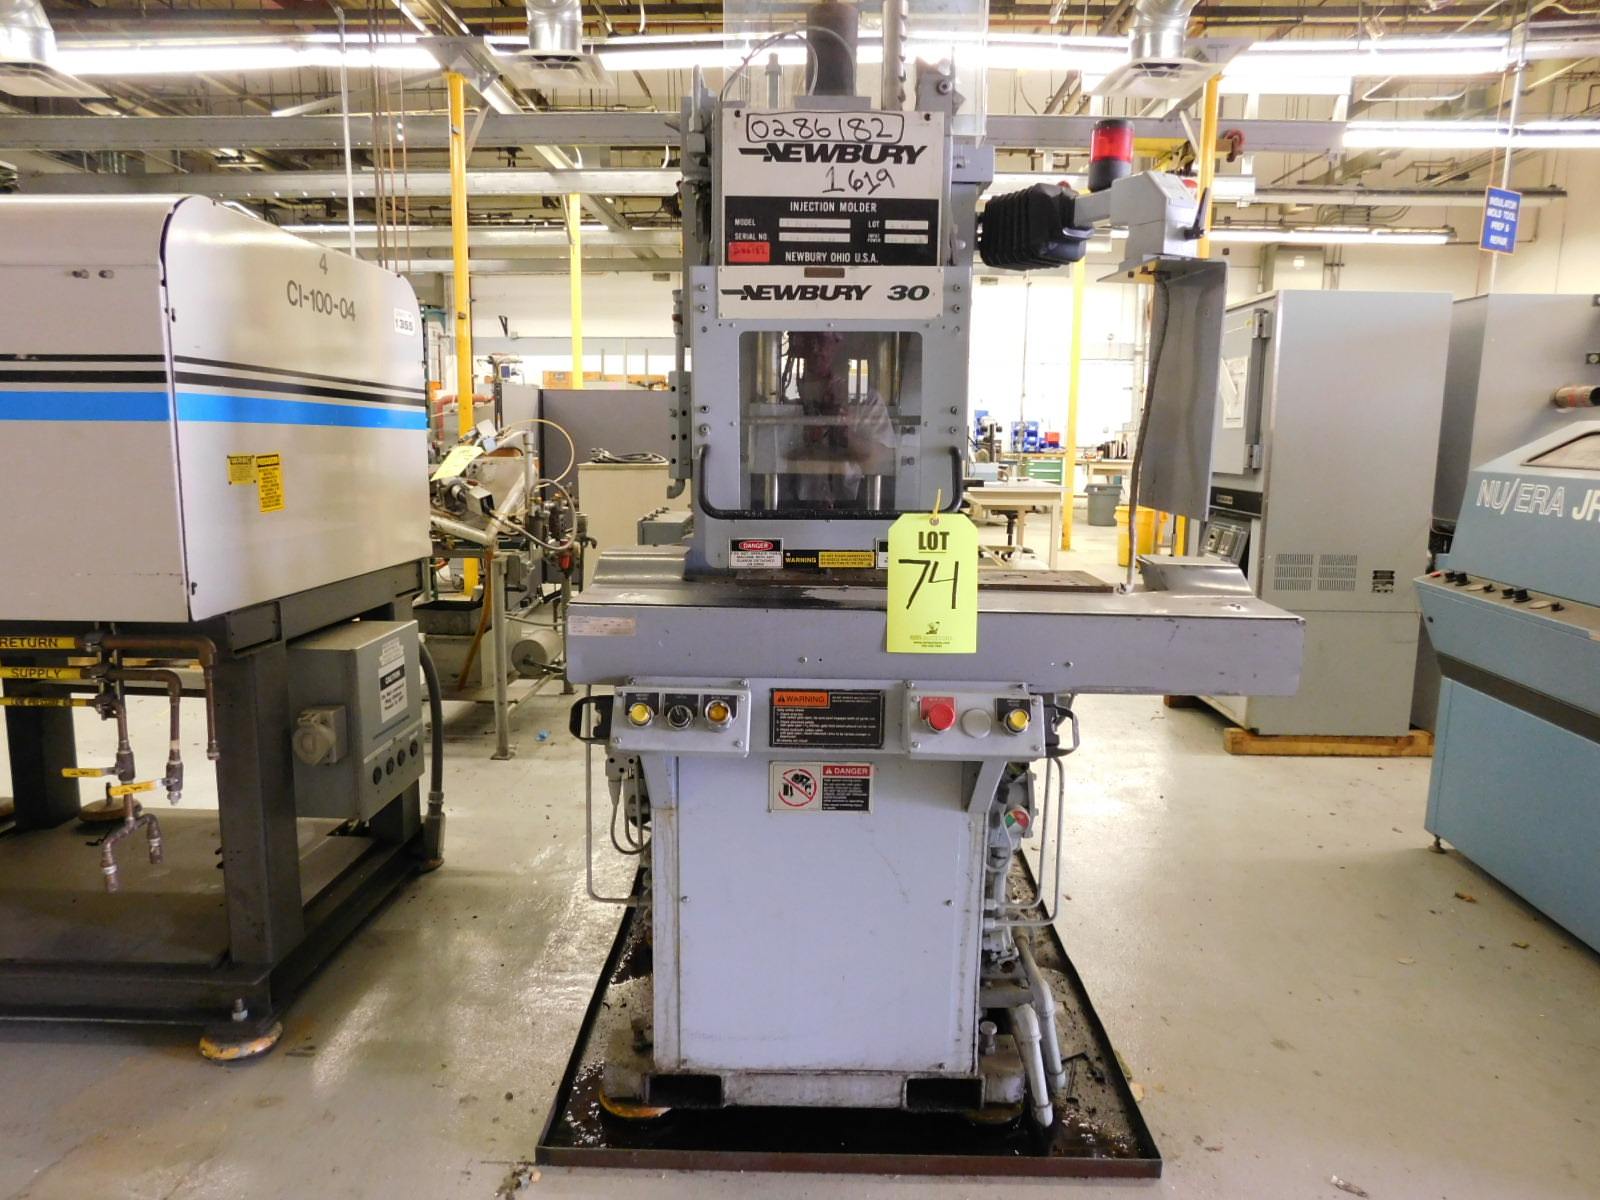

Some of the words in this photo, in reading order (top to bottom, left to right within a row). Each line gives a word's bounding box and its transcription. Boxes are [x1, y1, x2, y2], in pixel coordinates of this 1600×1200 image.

[751, 117, 893, 142] 0286182
[763, 143, 927, 165] NEWBURY
[821, 166, 896, 196] 1619
[789, 201, 835, 212] INJECTION
[839, 202, 877, 213] MOLDER
[734, 218, 756, 226] MODEL
[868, 220, 880, 228] LOT
[734, 232, 757, 240] SERIAL
[319, 252, 329, 275] 4
[785, 251, 827, 262] NEWBURY
[830, 252, 850, 263] OHIO
[854, 252, 879, 264] U.S.A.
[741, 284, 872, 301] NEWBURY
[887, 284, 930, 301] 30
[287, 280, 356, 321] CI-100-04
[1476, 478, 1565, 517] NU/ERA
[918, 531, 950, 550] LOT
[898, 558, 959, 610] 74
[0, 638, 58, 648] RETURN
[11, 668, 61, 678] SUPPLY
[786, 695, 825, 704] WARNING
[834, 767, 868, 775] DANGER
